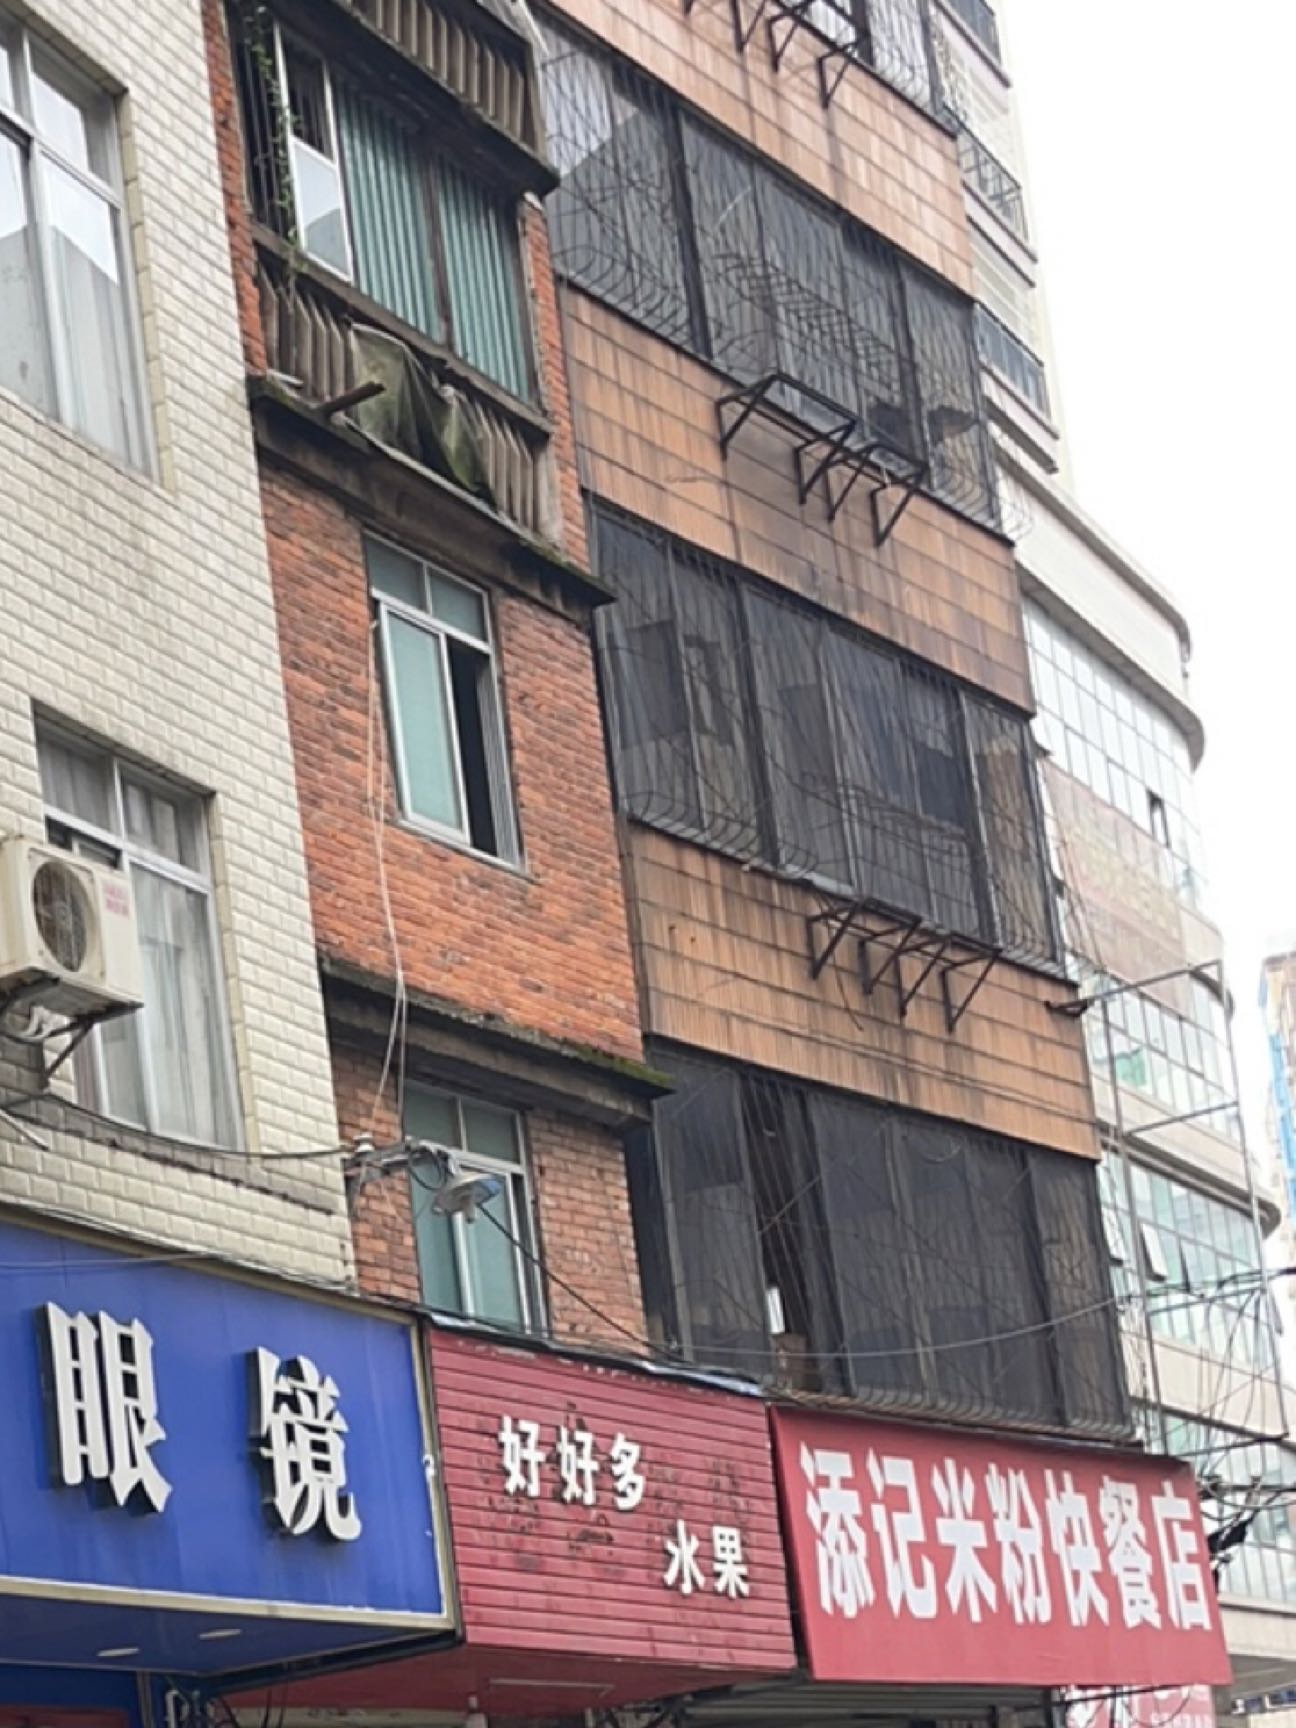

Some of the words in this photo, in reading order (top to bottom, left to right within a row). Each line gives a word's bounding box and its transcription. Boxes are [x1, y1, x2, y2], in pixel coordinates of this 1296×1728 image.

[499, 1415, 646, 1513] 好好多
[662, 1520, 750, 1600] 水果
[799, 1441, 1212, 1631] 添记米粉快餐店
